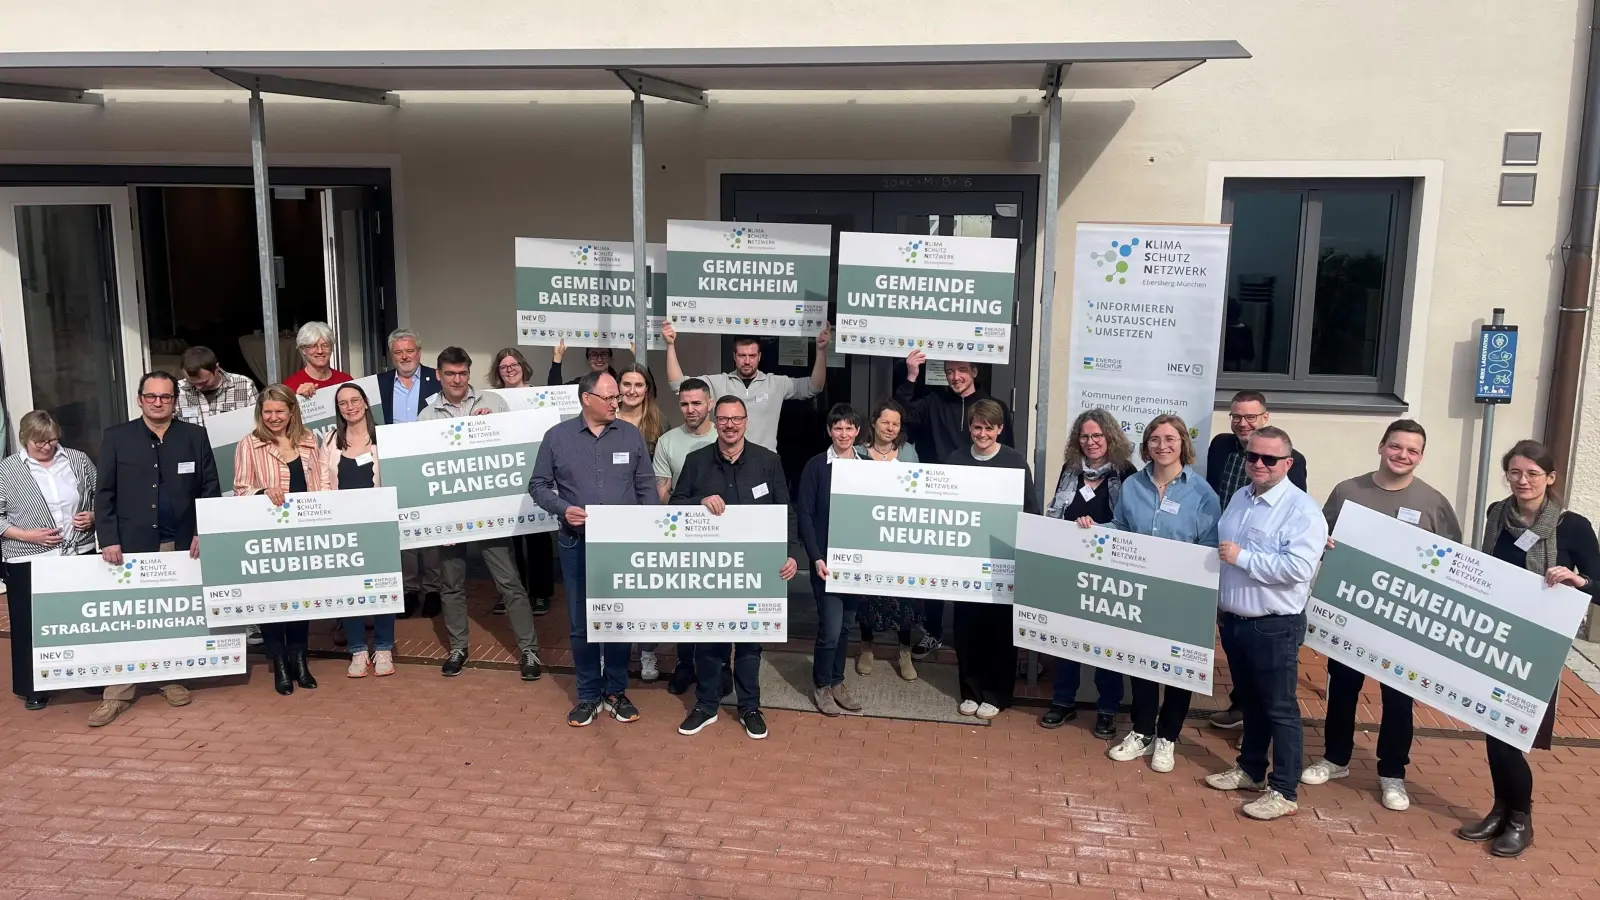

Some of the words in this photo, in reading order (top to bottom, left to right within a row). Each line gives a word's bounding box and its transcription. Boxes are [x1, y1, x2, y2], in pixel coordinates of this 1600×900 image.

[1145, 240, 1182, 249] KLIMA
[1144, 252, 1190, 262] SCHUTZ
[702, 260, 795, 275] GEMEINDE
[1144, 265, 1206, 276] NETZWERK
[698, 277, 798, 293] KIRCHHEIM
[875, 274, 975, 294] GEMEINDE
[847, 292, 1002, 315] UNTERHACHING
[1096, 301, 1174, 314] INFORMIEREN
[1096, 314, 1176, 327] AUSTAUSCHEN
[1096, 327, 1153, 339] UMSETZEN
[1168, 363, 1191, 373] INEV
[1081, 390, 1133, 401] Kommunen
[1135, 395, 1188, 407] gemeinsam
[1097, 402, 1120, 411] mehr
[1122, 404, 1177, 416] Klimaschutz
[421, 452, 526, 477] GEMEINDE
[428, 472, 523, 496] PLANEGG
[872, 504, 981, 527] GEMEINDE
[245, 532, 358, 555] GEMEINDE
[880, 526, 971, 548] NEURIED
[1112, 544, 1138, 553] SCHUTZ
[240, 552, 364, 575] NEUBIBERG
[630, 551, 744, 568] GEMEINDE
[832, 553, 852, 561] INEV
[1455, 552, 1480, 566] KLIMA
[1452, 560, 1484, 576] SCHUTZ
[613, 573, 761, 589] FELDKIRCHEN
[1449, 567, 1492, 588] NETZWERK
[1076, 572, 1147, 601] STADT
[81, 596, 202, 618] GEMEINDE
[1080, 594, 1142, 624] HAAR
[1312, 604, 1335, 620] INEV
[1371, 570, 1512, 643] GEMEINDE
[1018, 611, 1037, 620] INEV
[1336, 580, 1533, 680] HOHENBRUNN
[40, 652, 61, 660] INEV
